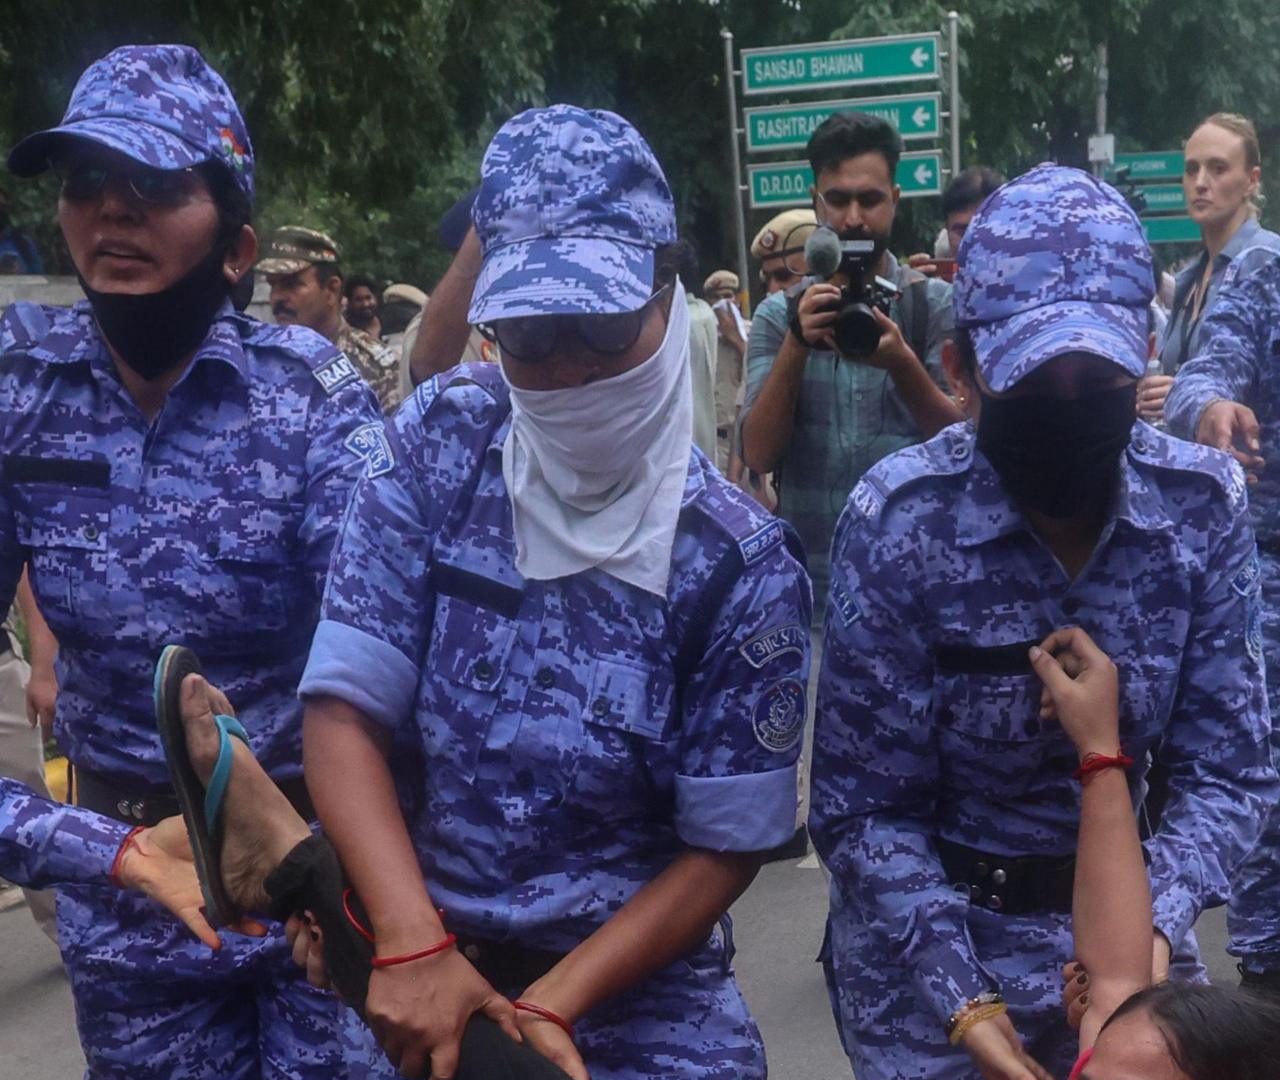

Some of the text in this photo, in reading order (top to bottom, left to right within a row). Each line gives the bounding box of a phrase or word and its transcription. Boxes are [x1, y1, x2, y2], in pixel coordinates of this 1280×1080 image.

[754, 52, 864, 82] SANSAD BHAWAN
[756, 114, 829, 140] RASHTRAP
